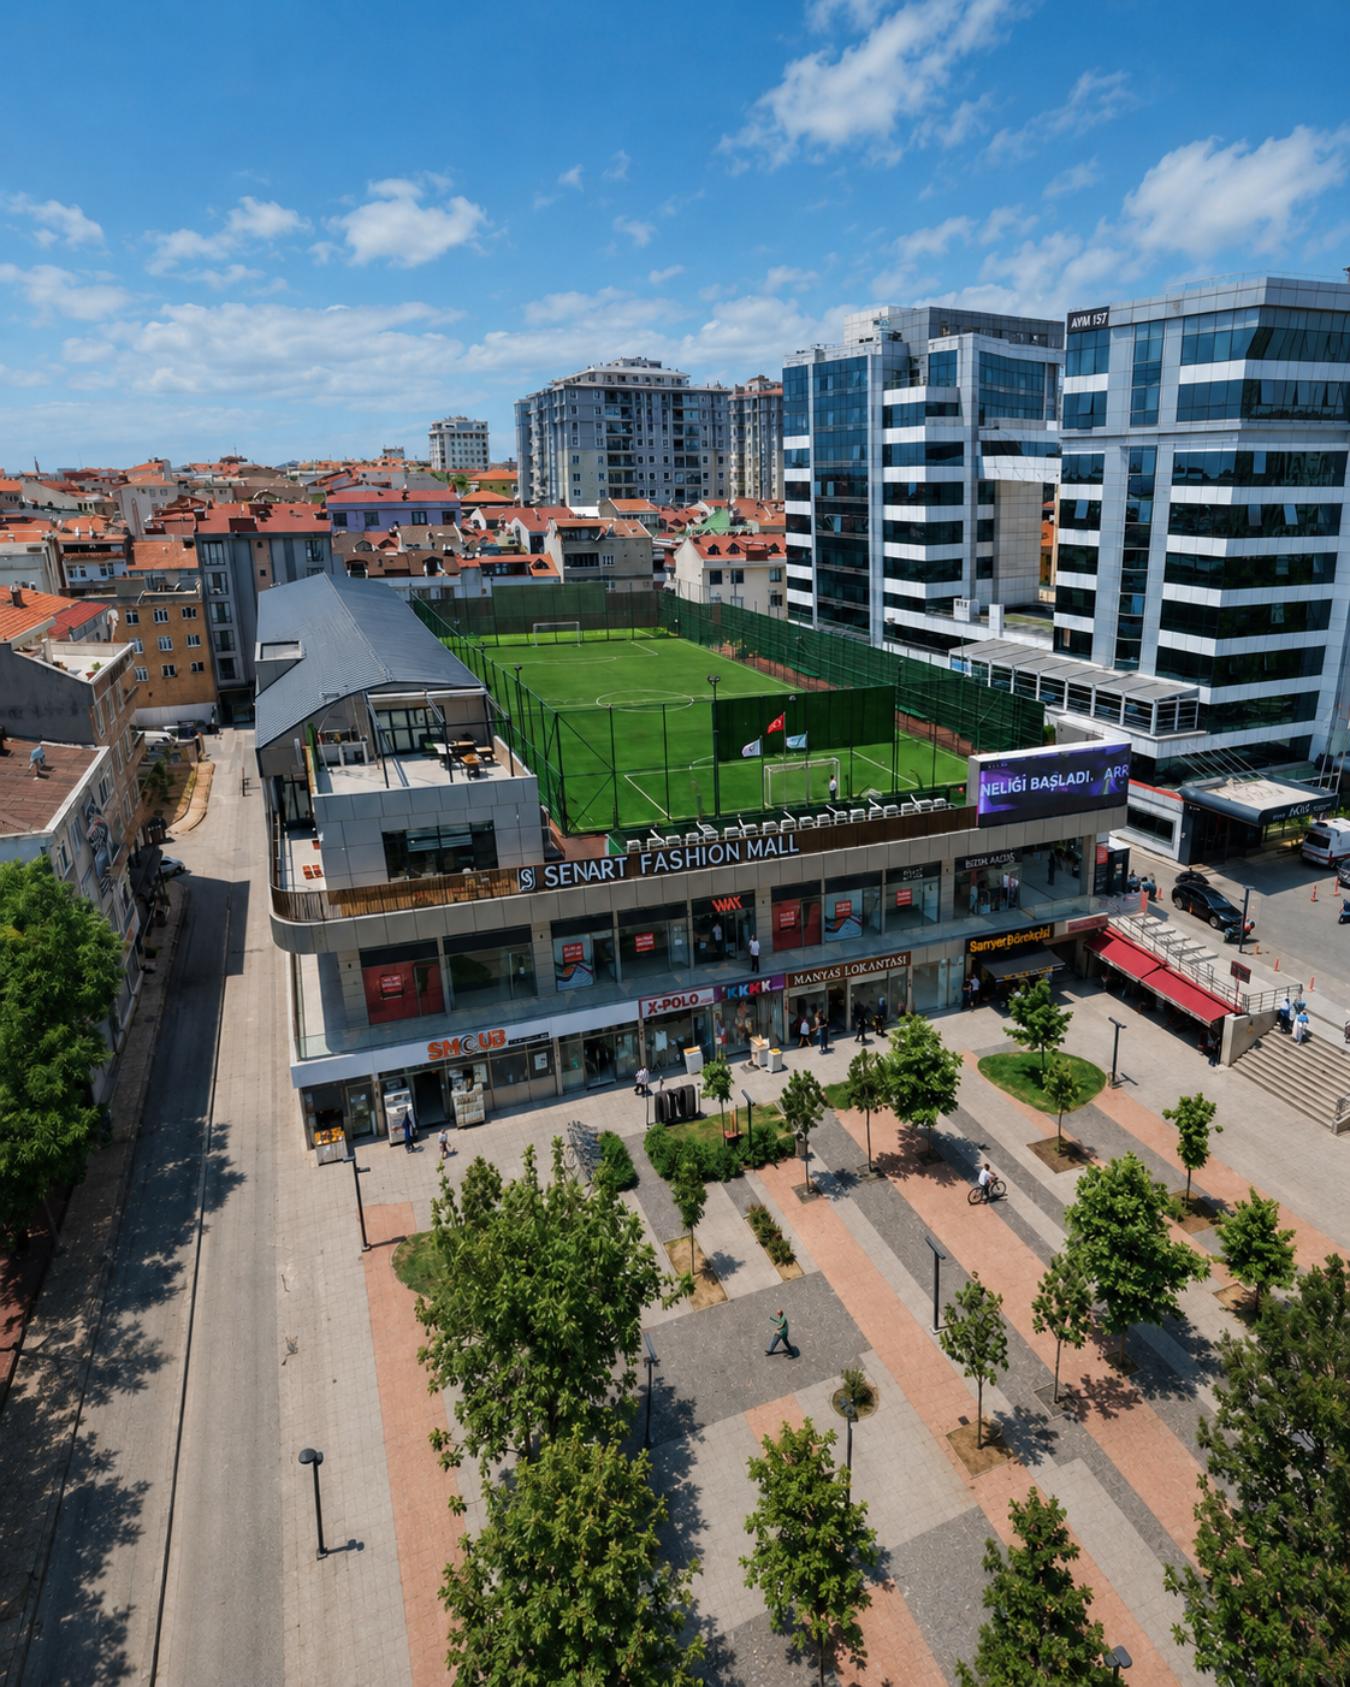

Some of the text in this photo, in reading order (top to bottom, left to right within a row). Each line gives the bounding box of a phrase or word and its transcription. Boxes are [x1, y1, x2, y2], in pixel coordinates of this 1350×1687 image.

[1092, 312, 1108, 326] 157
[544, 857, 628, 887] SENART
[640, 842, 740, 875] FASHION
[746, 834, 800, 860] MALL
[793, 955, 907, 986] MANYAS LOKANTASI
[648, 993, 700, 1015] X-POLO
